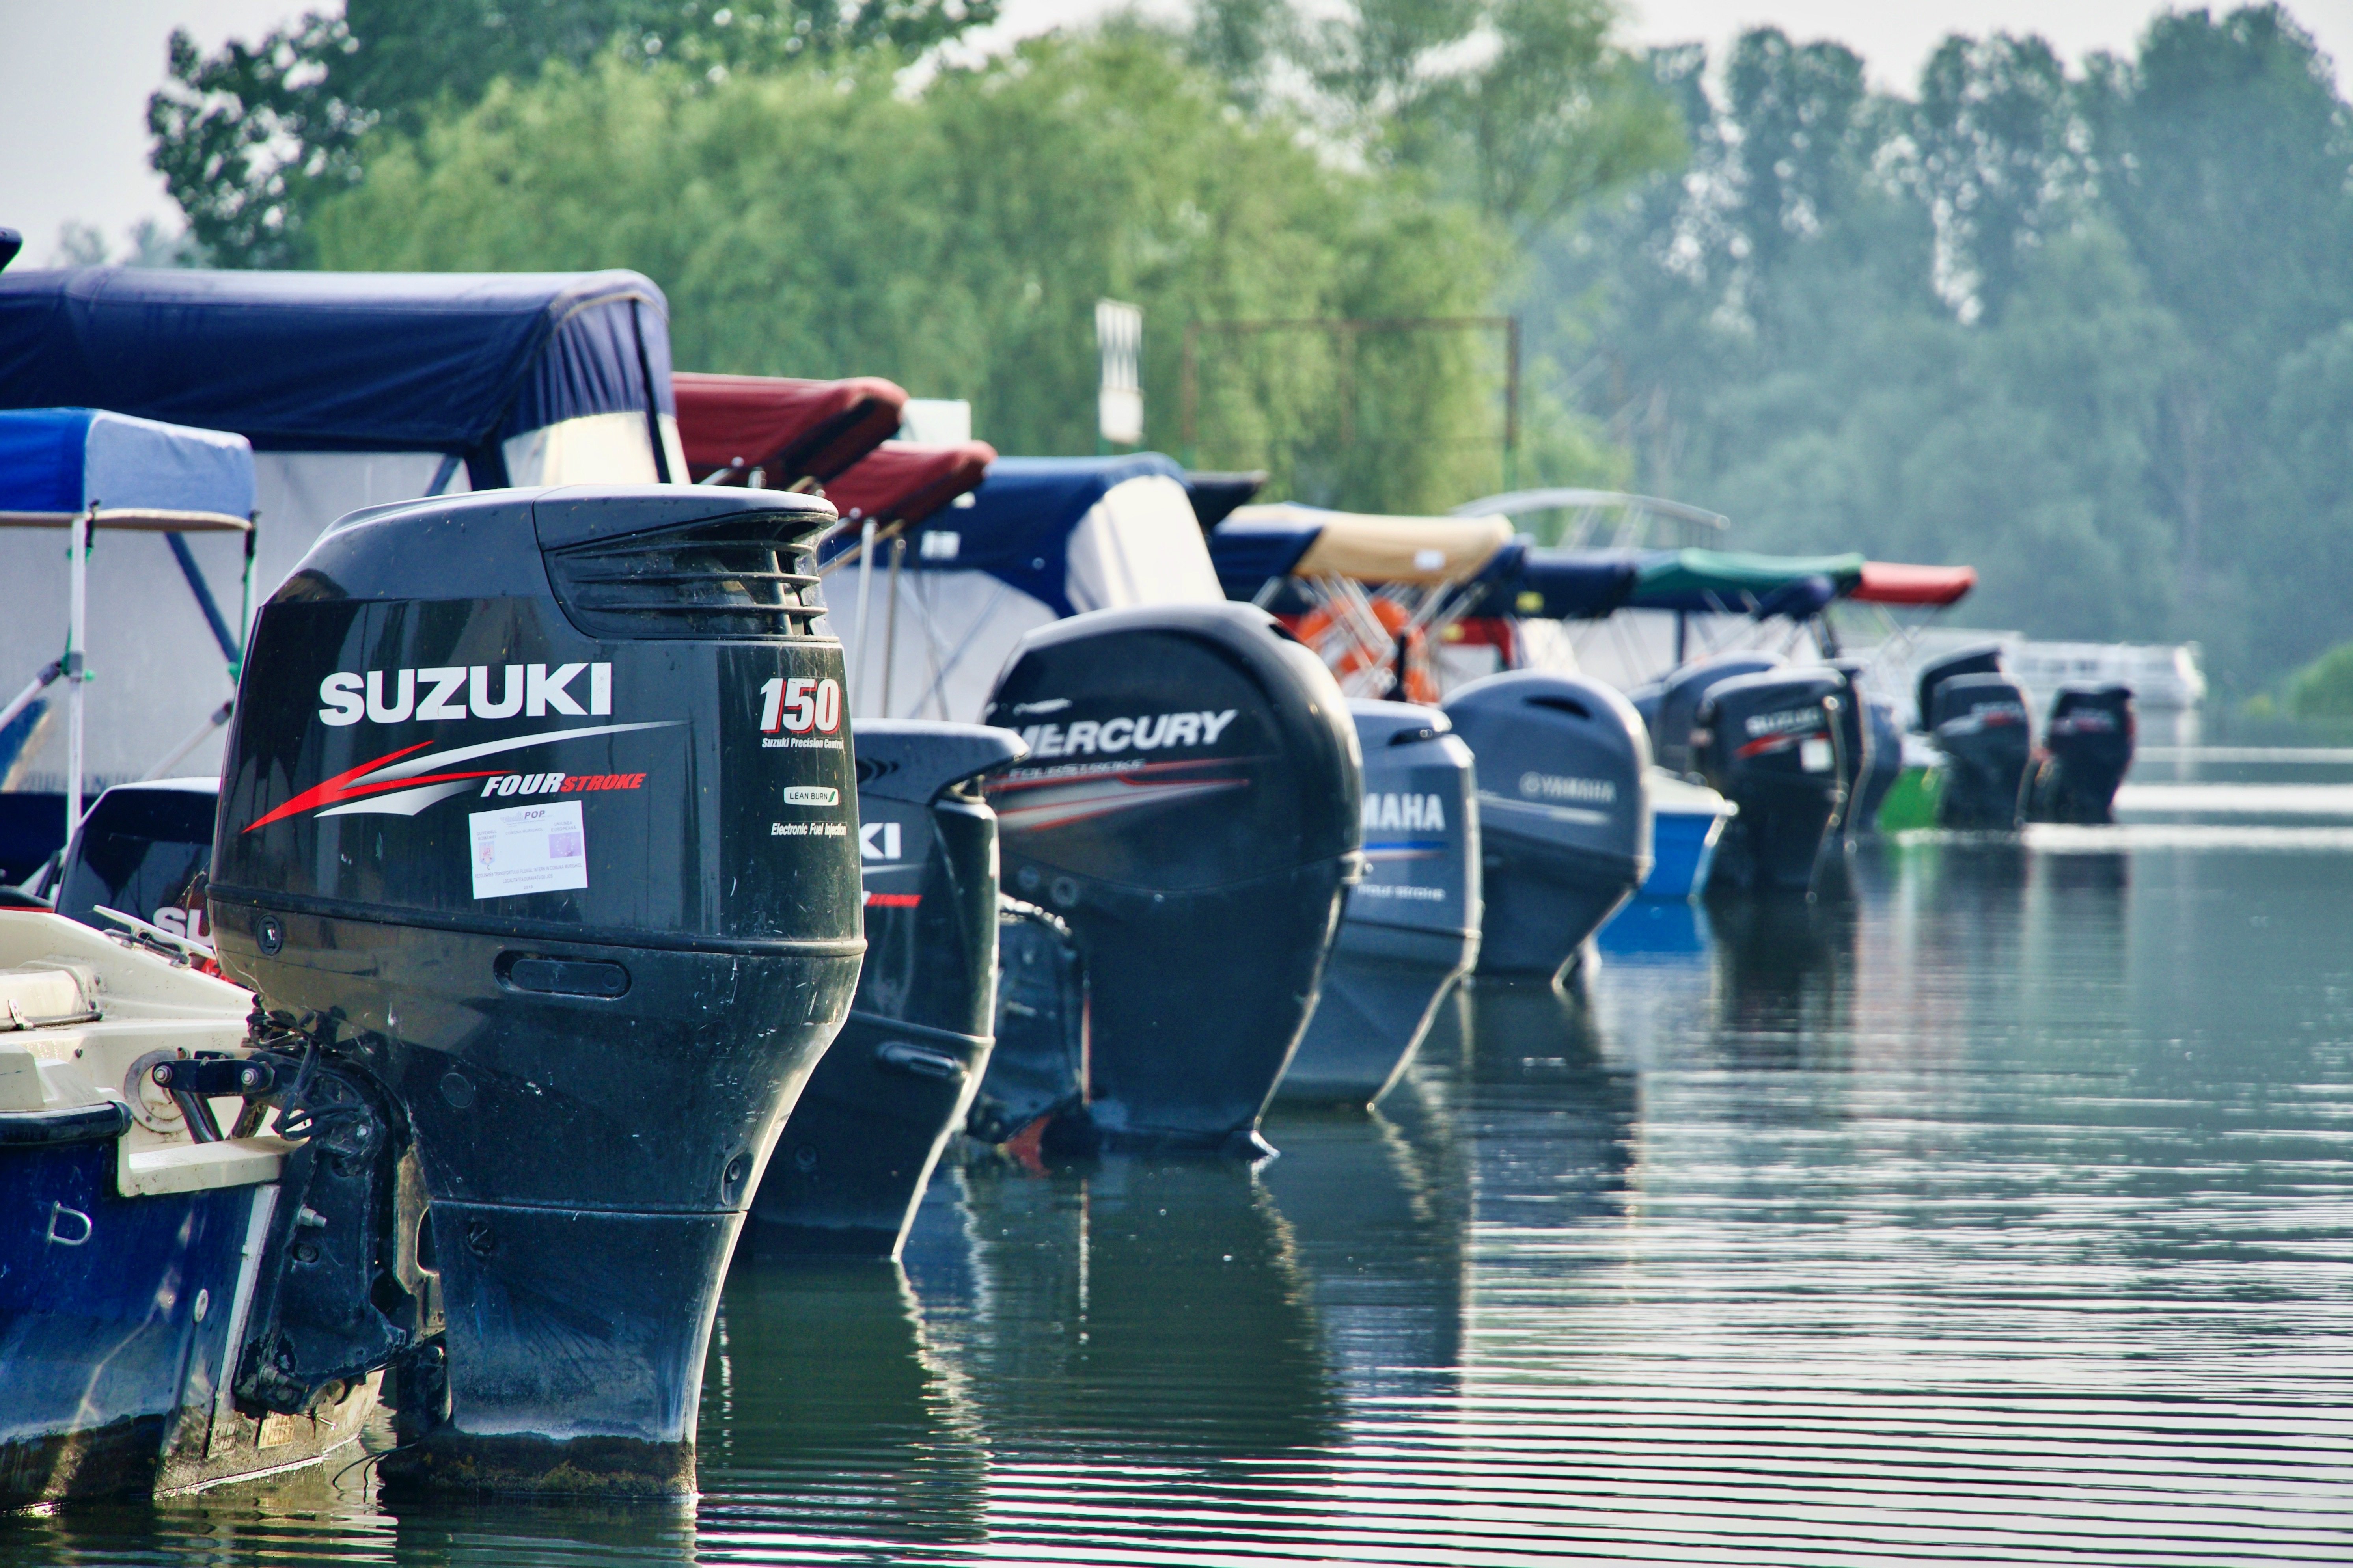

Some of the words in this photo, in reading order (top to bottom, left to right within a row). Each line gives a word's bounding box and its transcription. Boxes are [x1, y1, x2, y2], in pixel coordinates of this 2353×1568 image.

[319, 662, 612, 726] SUZUKI
[760, 678, 841, 734] 150
[762, 737, 789, 748] Suzuki
[790, 738, 823, 748] Precision
[824, 738, 844, 749] Control
[524, 810, 545, 819] POP
[771, 822, 808, 836] Electronic
[809, 822, 824, 835] Fuel
[824, 823, 846, 839] Injection
